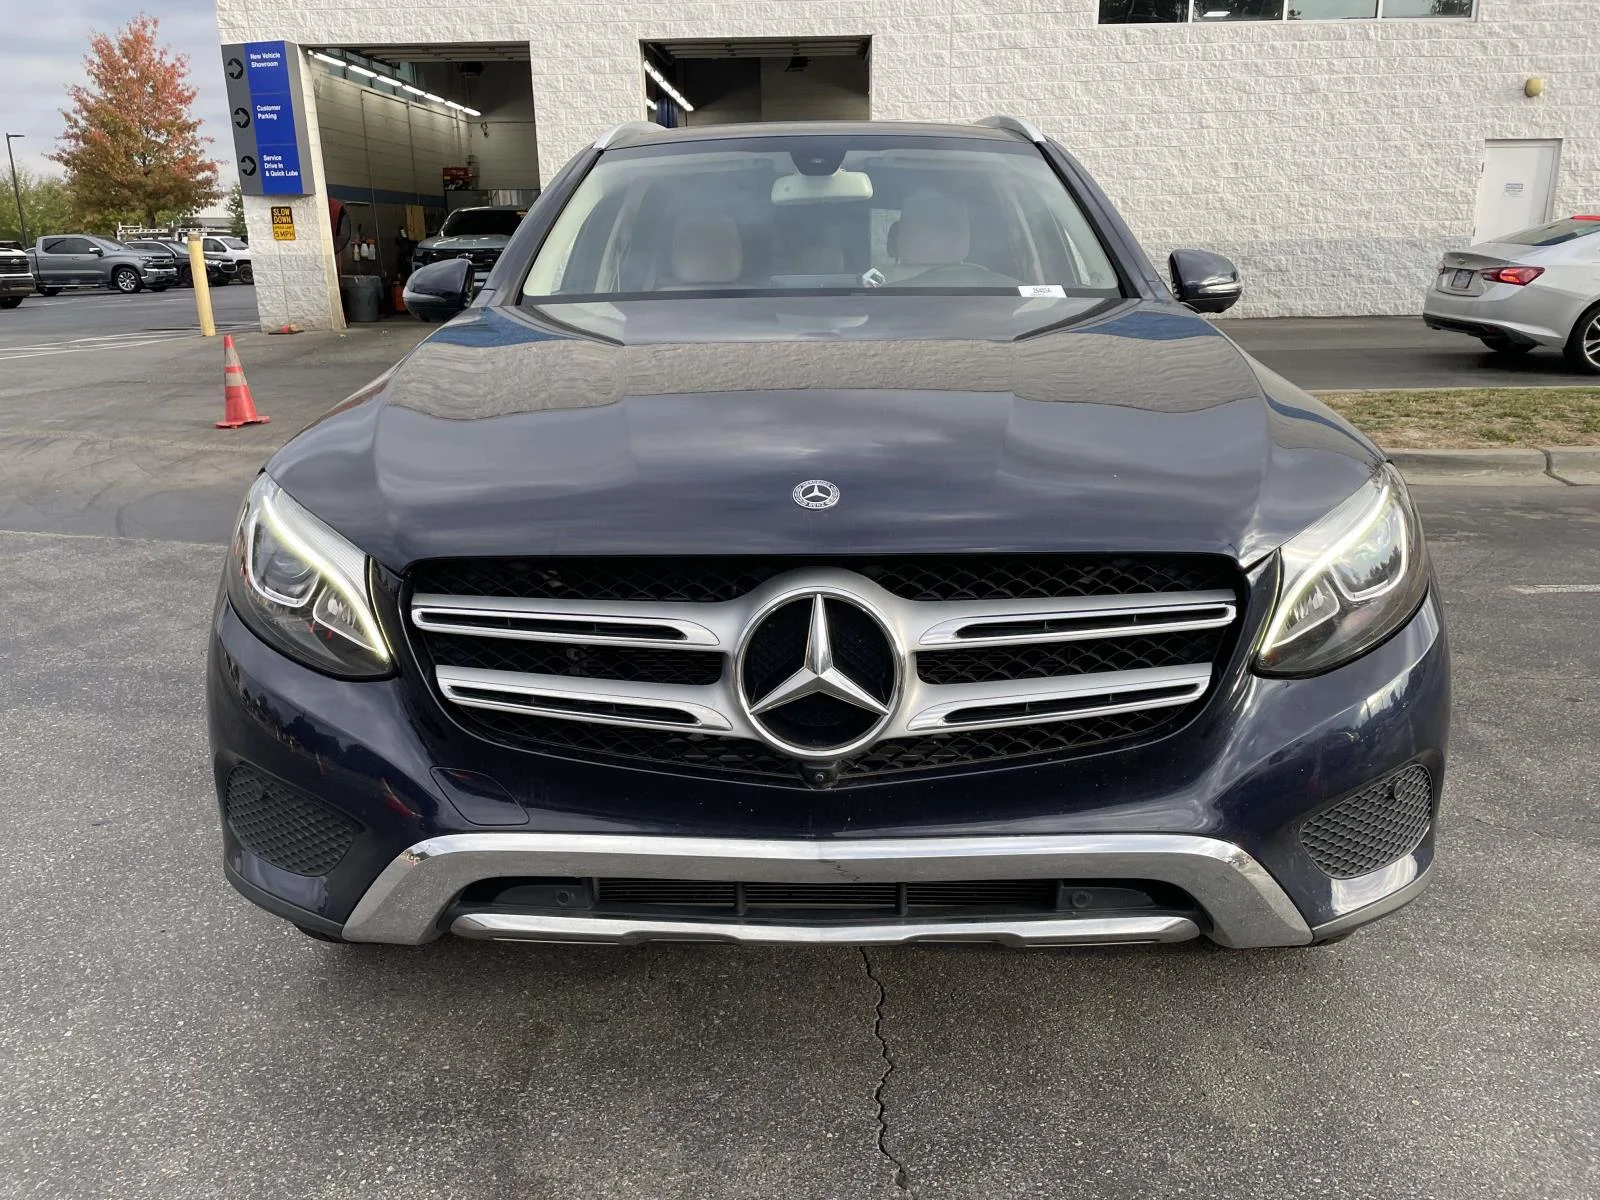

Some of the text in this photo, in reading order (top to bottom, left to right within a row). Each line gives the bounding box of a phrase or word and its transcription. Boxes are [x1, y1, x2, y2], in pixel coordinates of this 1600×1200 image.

[273, 208, 290, 216] SLOW
[273, 216, 292, 224] DOWN
[280, 230, 294, 239] MPH
